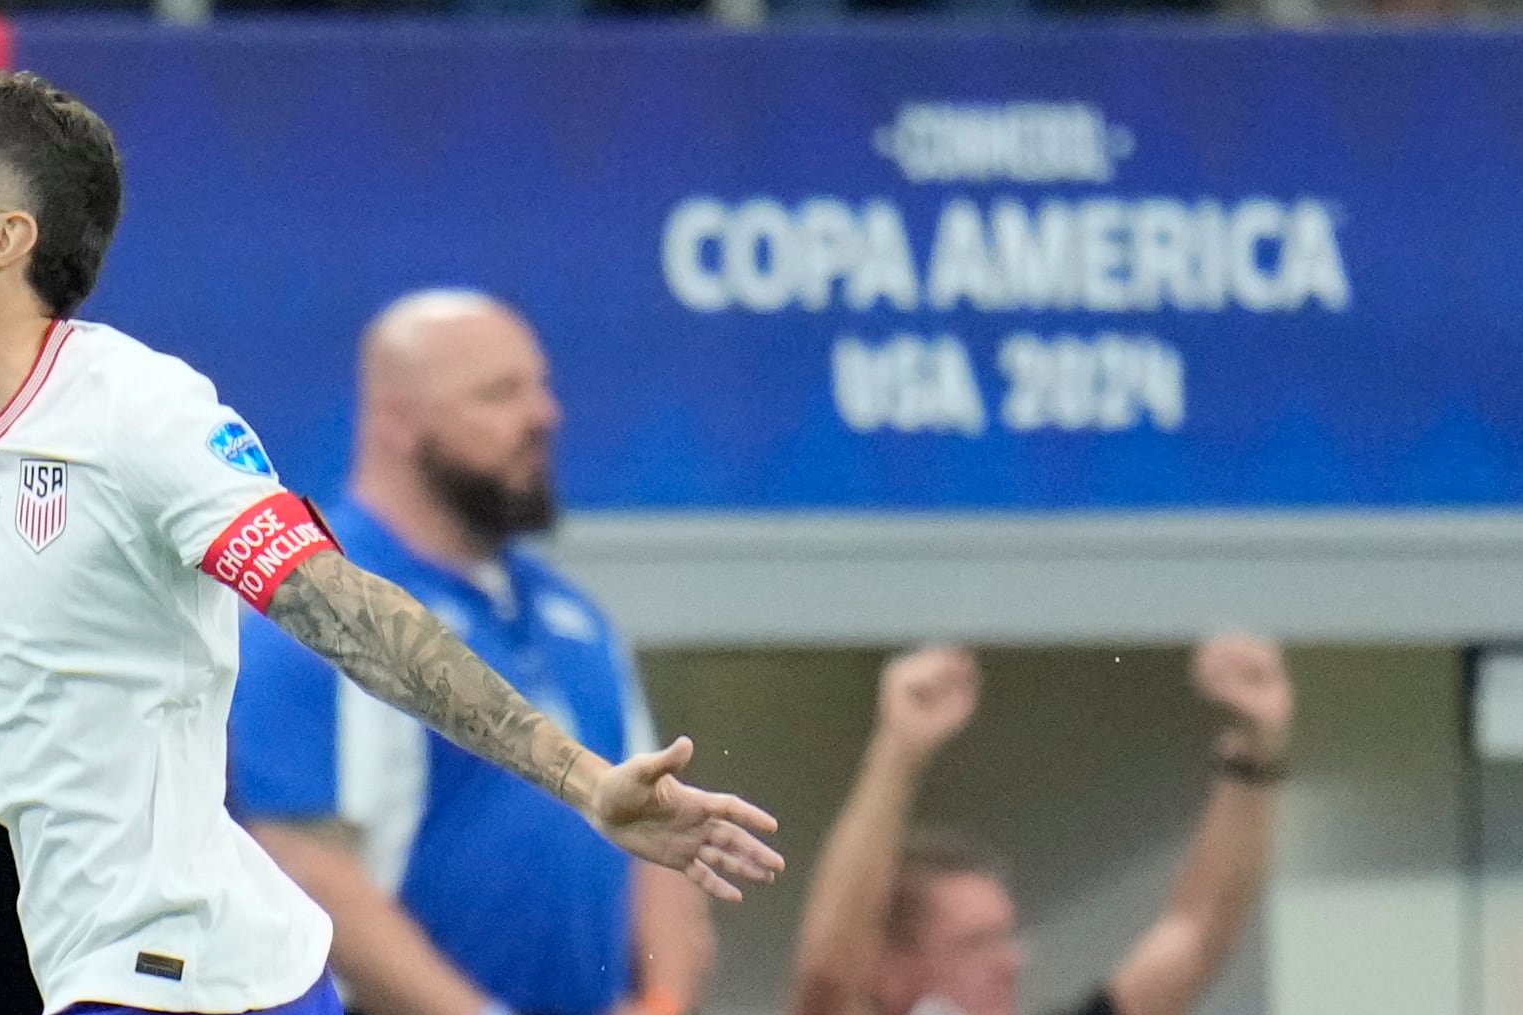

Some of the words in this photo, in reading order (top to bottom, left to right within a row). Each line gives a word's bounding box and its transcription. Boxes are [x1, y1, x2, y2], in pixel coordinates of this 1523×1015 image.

[663, 198, 919, 311] COPA
[929, 198, 1350, 311] AMERICA
[832, 335, 986, 434] USA
[998, 334, 1184, 432] 2024
[24, 465, 63, 498] USA
[216, 508, 285, 581] CHOOSE
[238, 570, 263, 600] TO
[253, 522, 327, 579] INCLUDE
